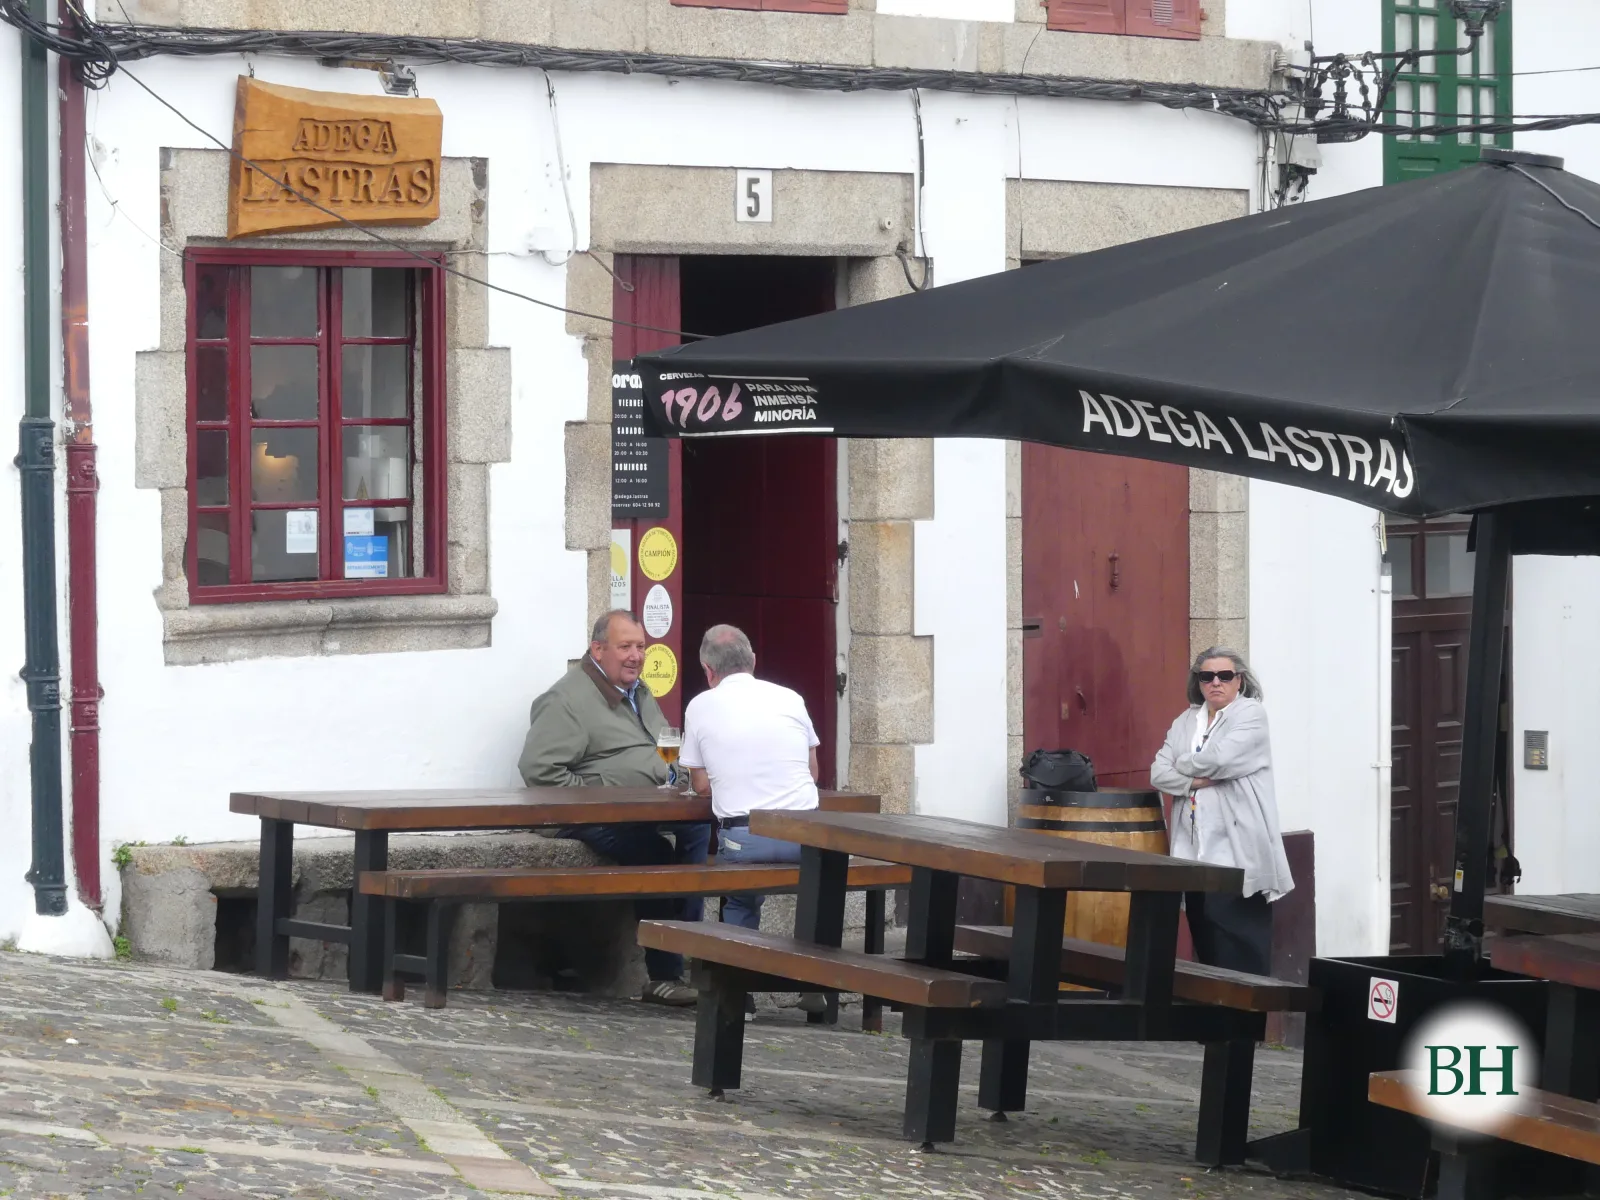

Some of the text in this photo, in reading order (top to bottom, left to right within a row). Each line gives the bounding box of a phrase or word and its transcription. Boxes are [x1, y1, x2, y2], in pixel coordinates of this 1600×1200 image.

[291, 118, 398, 153] ADEGA
[242, 161, 434, 204] LASTRAS
[747, 177, 760, 217] 5
[745, 383, 818, 393] PARA UNA
[661, 383, 742, 428] 1906
[753, 394, 818, 407] INMENSA
[754, 405, 817, 422] MINORÍA
[1079, 389, 1234, 455] ADEGA
[615, 463, 648, 471] DOMINGOS
[645, 548, 671, 557] CAMPIÓN
[653, 660, 662, 671] 3º
